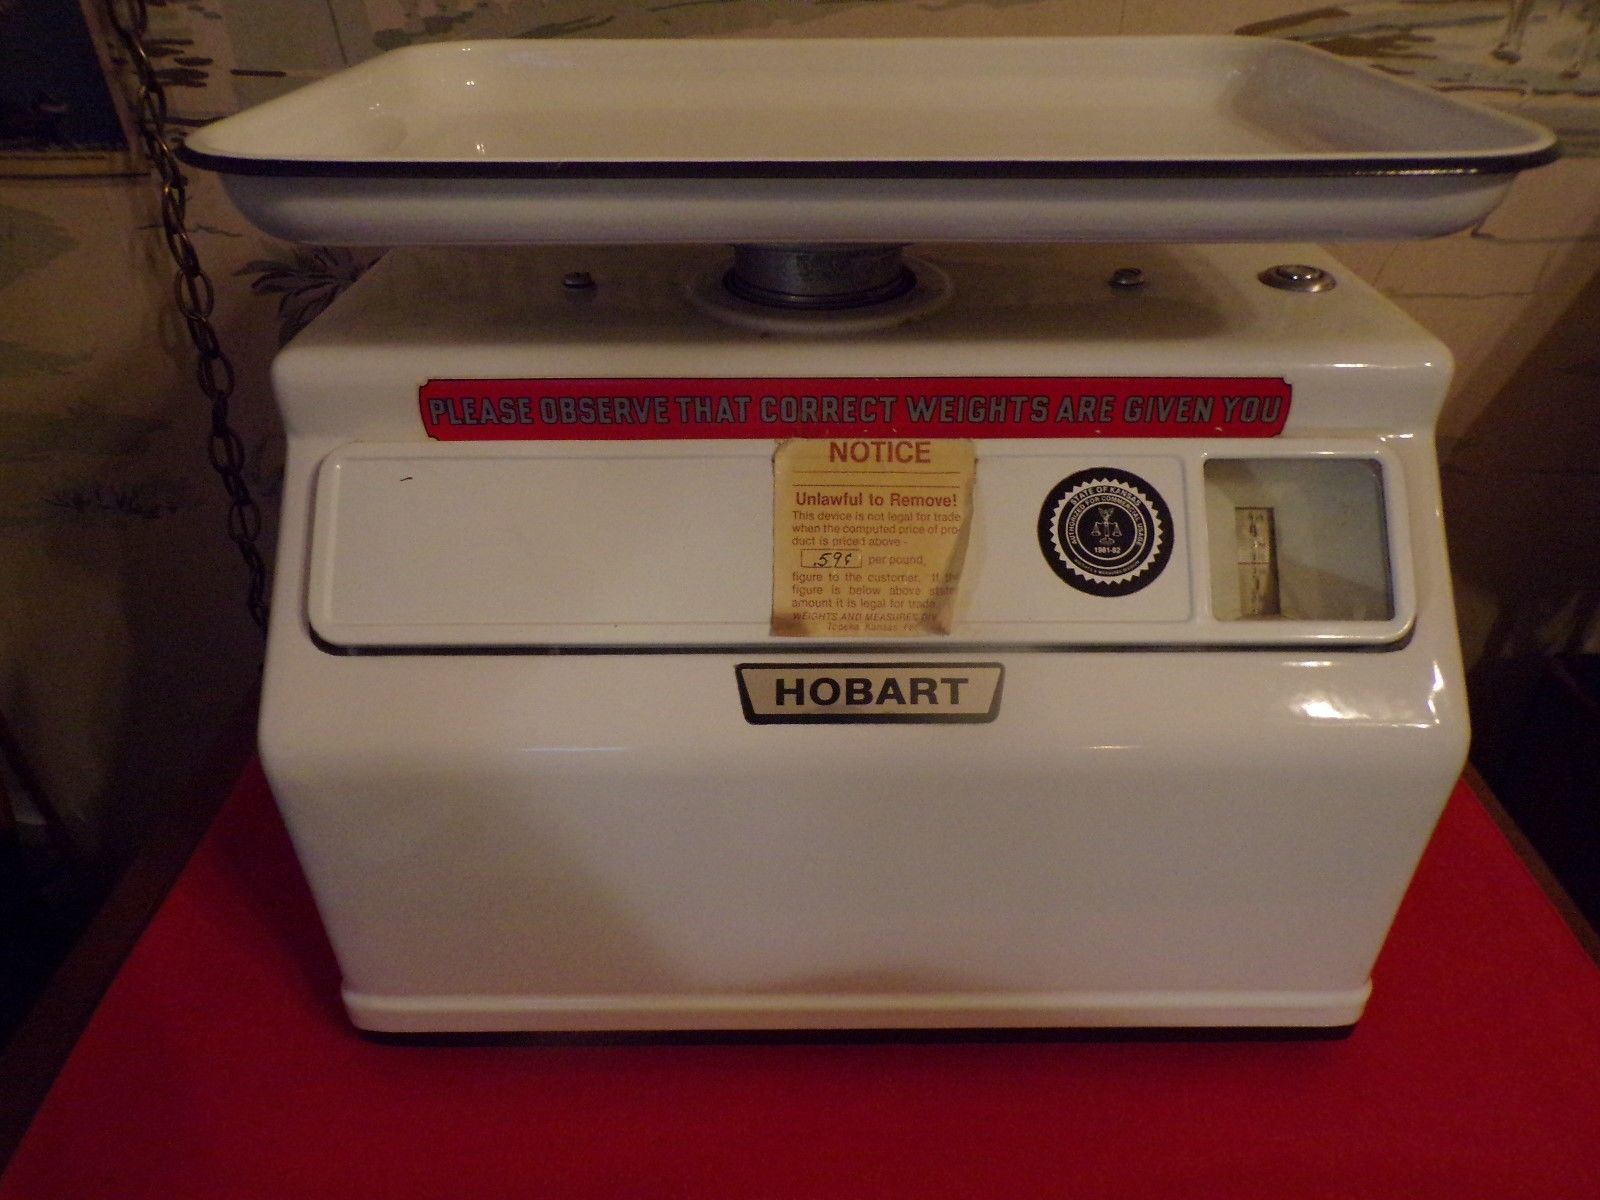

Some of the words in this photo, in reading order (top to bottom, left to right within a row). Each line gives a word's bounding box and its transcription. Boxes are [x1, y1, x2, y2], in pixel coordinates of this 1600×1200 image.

[429, 397, 533, 425] PLEASE
[539, 397, 669, 425] OBSERVE
[675, 396, 752, 425] THAT
[760, 396, 897, 424] CORRECT
[906, 395, 1050, 424] WEIGHTS
[1055, 395, 1114, 423] ARE
[1123, 395, 1214, 423] GIVEN
[1222, 395, 1282, 423] YOU
[829, 441, 931, 464] NOTICE
[796, 492, 863, 506] Unlawful
[869, 493, 884, 506] to
[890, 493, 957, 507] Remove!
[1071, 487, 1093, 505] STATE
[1109, 486, 1141, 507] KANSAS
[1085, 496, 1100, 507] FOR
[793, 511, 815, 520] This
[817, 511, 851, 521] device
[855, 512, 864, 521] is
[867, 512, 884, 521] not
[888, 512, 912, 523] legal
[916, 512, 930, 521] for
[934, 512, 960, 521] trade
[792, 524, 820, 533] when
[823, 524, 840, 533] the
[843, 525, 895, 535] computed
[899, 525, 924, 535] price
[927, 525, 938, 534] of
[792, 536, 815, 545] duct
[819, 537, 829, 545] is
[868, 556, 886, 565] per
[792, 573, 822, 583] figure
[829, 573, 839, 582] to
[845, 573, 862, 582] the
[792, 586, 823, 597] figure
[832, 586, 840, 595] is
[849, 586, 881, 595] below
[889, 587, 921, 595] above
[792, 599, 832, 608] amount
[836, 599, 843, 608] it
[847, 599, 856, 608] is
[860, 599, 886, 610] legal
[890, 600, 904, 608] for
[793, 612, 837, 621] WEIGHTS
[841, 613, 861, 621] AND
[775, 677, 968, 706] HOBART
